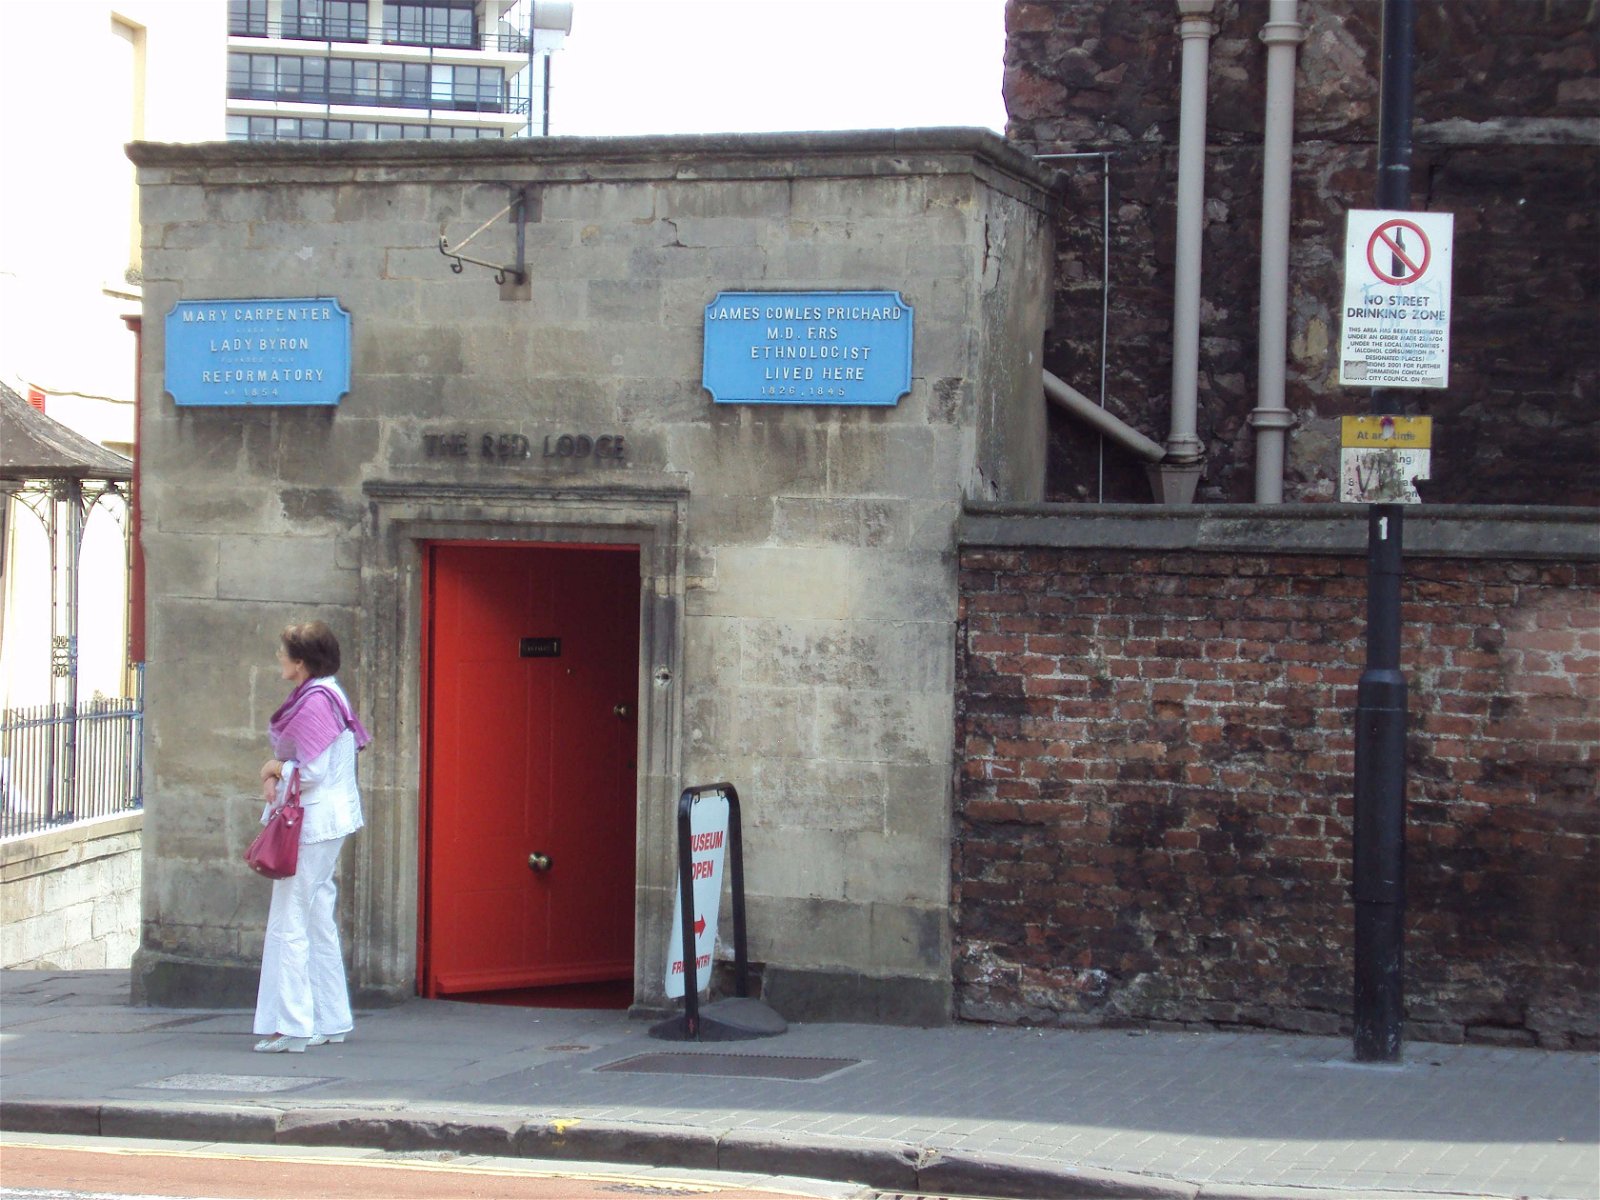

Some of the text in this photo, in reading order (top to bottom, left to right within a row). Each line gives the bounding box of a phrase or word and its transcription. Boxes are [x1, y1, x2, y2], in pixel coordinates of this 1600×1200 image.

[1364, 295, 1430, 307] NO STREET
[182, 308, 331, 322] MARY CARPENTER
[709, 306, 901, 320] JAMES COWLES PRICHARD
[1347, 307, 1446, 321] DRINKING ZONE
[210, 337, 309, 352] LADY BYRON
[202, 369, 324, 383] REFORMATORY
[765, 367, 865, 380] LIVED HERE
[423, 432, 468, 458] THE
[481, 432, 530, 458] RED
[1379, 516, 1389, 540] 1
